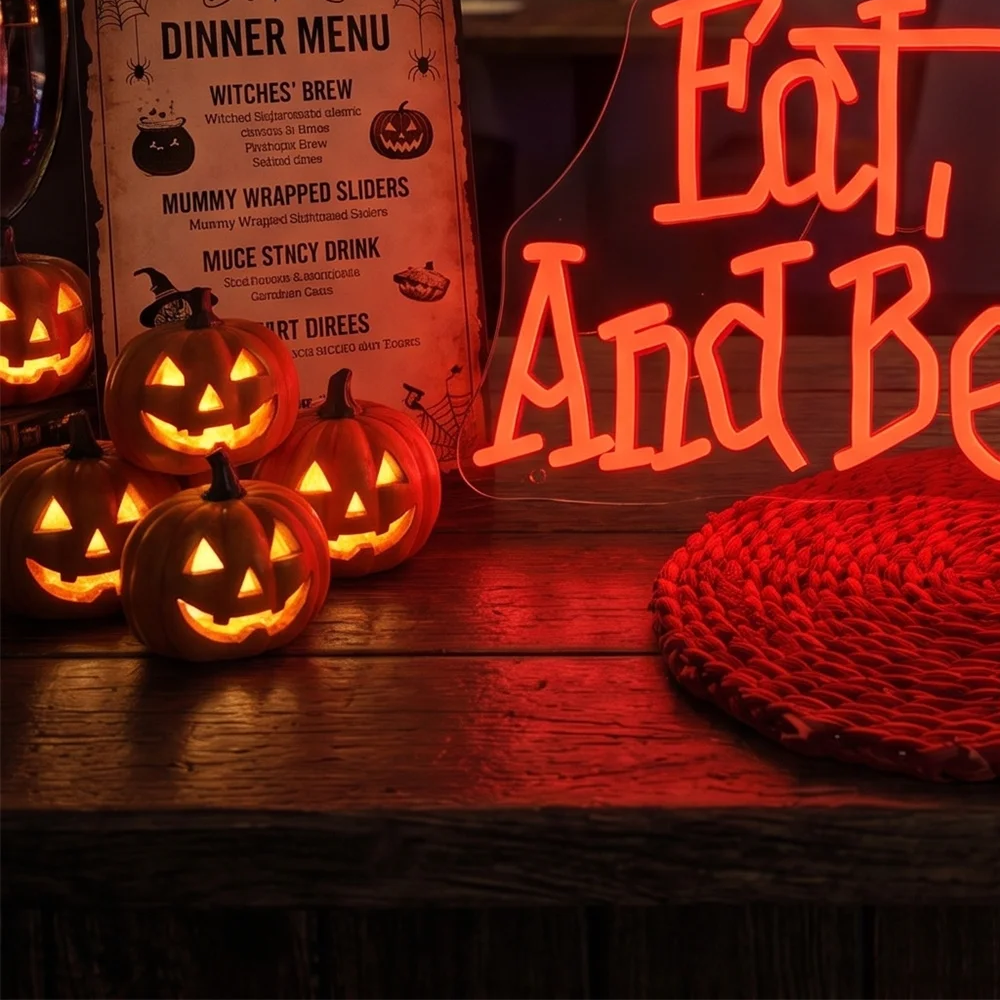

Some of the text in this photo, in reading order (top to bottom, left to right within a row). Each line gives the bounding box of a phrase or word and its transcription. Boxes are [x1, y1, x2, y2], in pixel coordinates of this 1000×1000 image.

[160, 13, 391, 61] DINNER MENU
[209, 78, 353, 106] WITCHES' BREW
[162, 175, 410, 215] MUMMY WRAPPED SLIDERS
[324, 236, 382, 262] DRINK
[305, 312, 370, 339] DIREES
[473, 240, 815, 474] And
